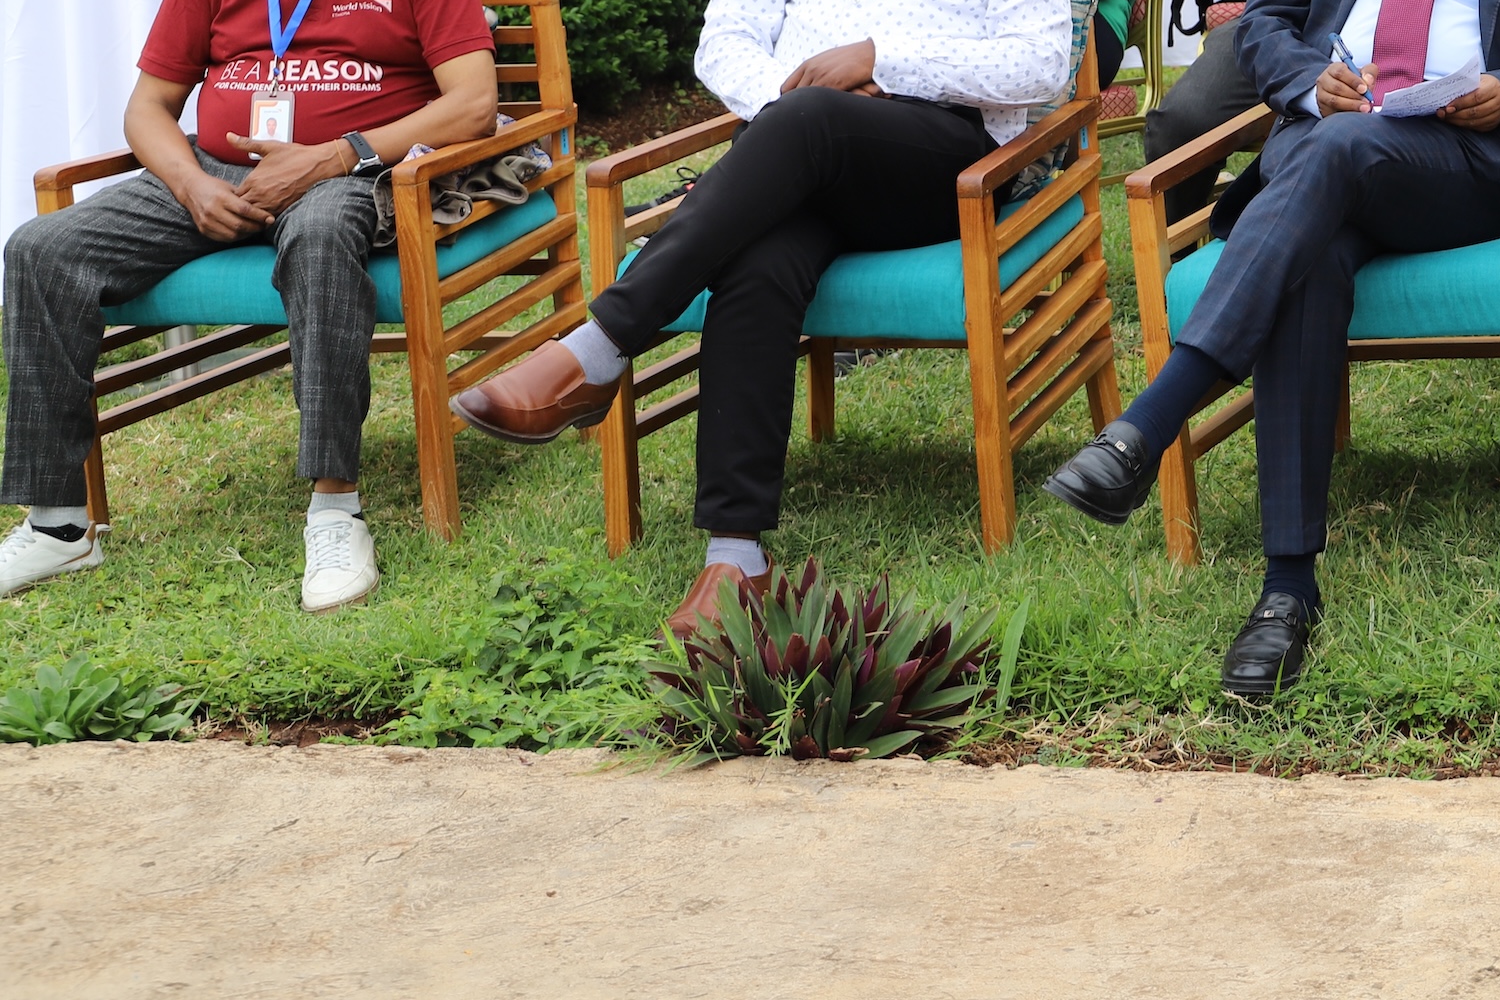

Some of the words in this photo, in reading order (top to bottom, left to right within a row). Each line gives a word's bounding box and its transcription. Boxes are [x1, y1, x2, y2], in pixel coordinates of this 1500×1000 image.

[332, 2, 358, 12] World
[359, 1, 383, 13] Vision
[221, 60, 245, 81] BE
[244, 61, 260, 81] A
[267, 60, 383, 81] REASON
[229, 82, 271, 92] CHILDREN
[287, 83, 309, 92] LIVE
[310, 83, 340, 92] THEIR
[342, 83, 382, 92] DREAMS
